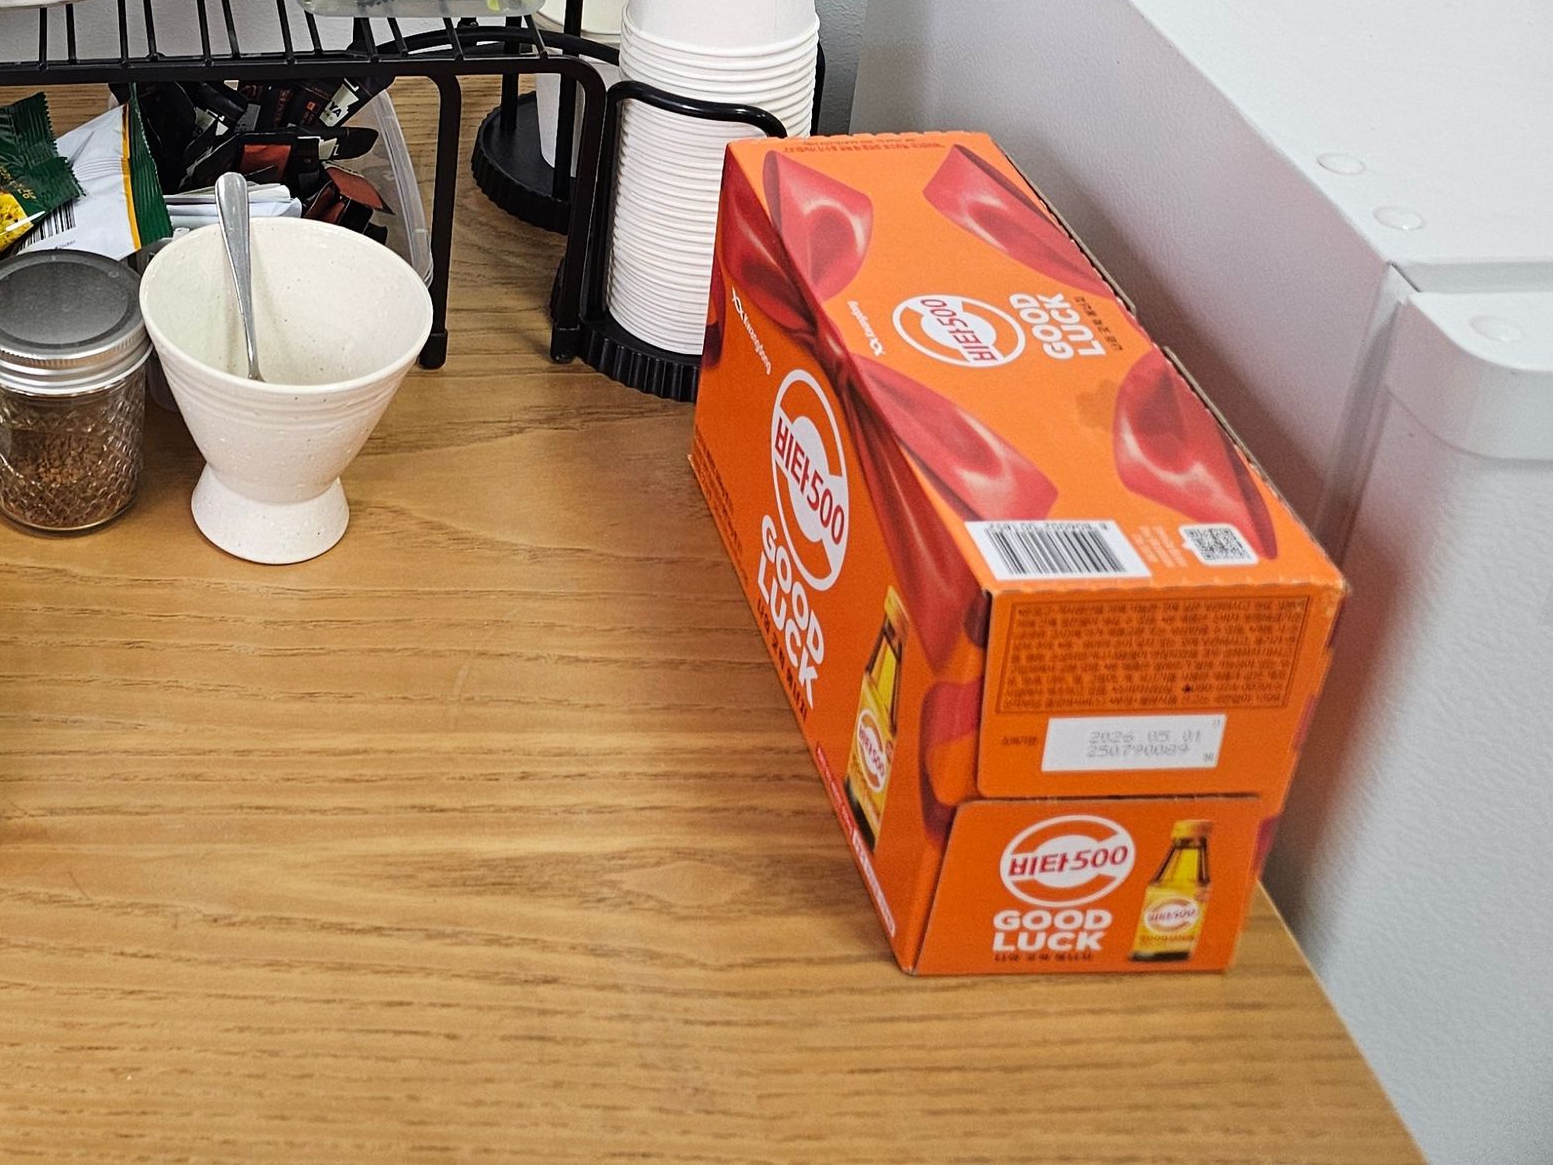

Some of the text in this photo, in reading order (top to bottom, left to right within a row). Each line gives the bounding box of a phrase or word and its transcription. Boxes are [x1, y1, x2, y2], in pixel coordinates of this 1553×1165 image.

[921, 298, 998, 362] 비타500
[1009, 293, 1074, 360] GOOD
[1037, 292, 1106, 356] LUCK
[775, 416, 845, 546] 비타500
[761, 514, 824, 665] GOOD
[758, 551, 818, 710] LUCK
[1008, 845, 1129, 876] 비타500
[991, 931, 1107, 952] LUCK
[993, 908, 1113, 931] GOOD
